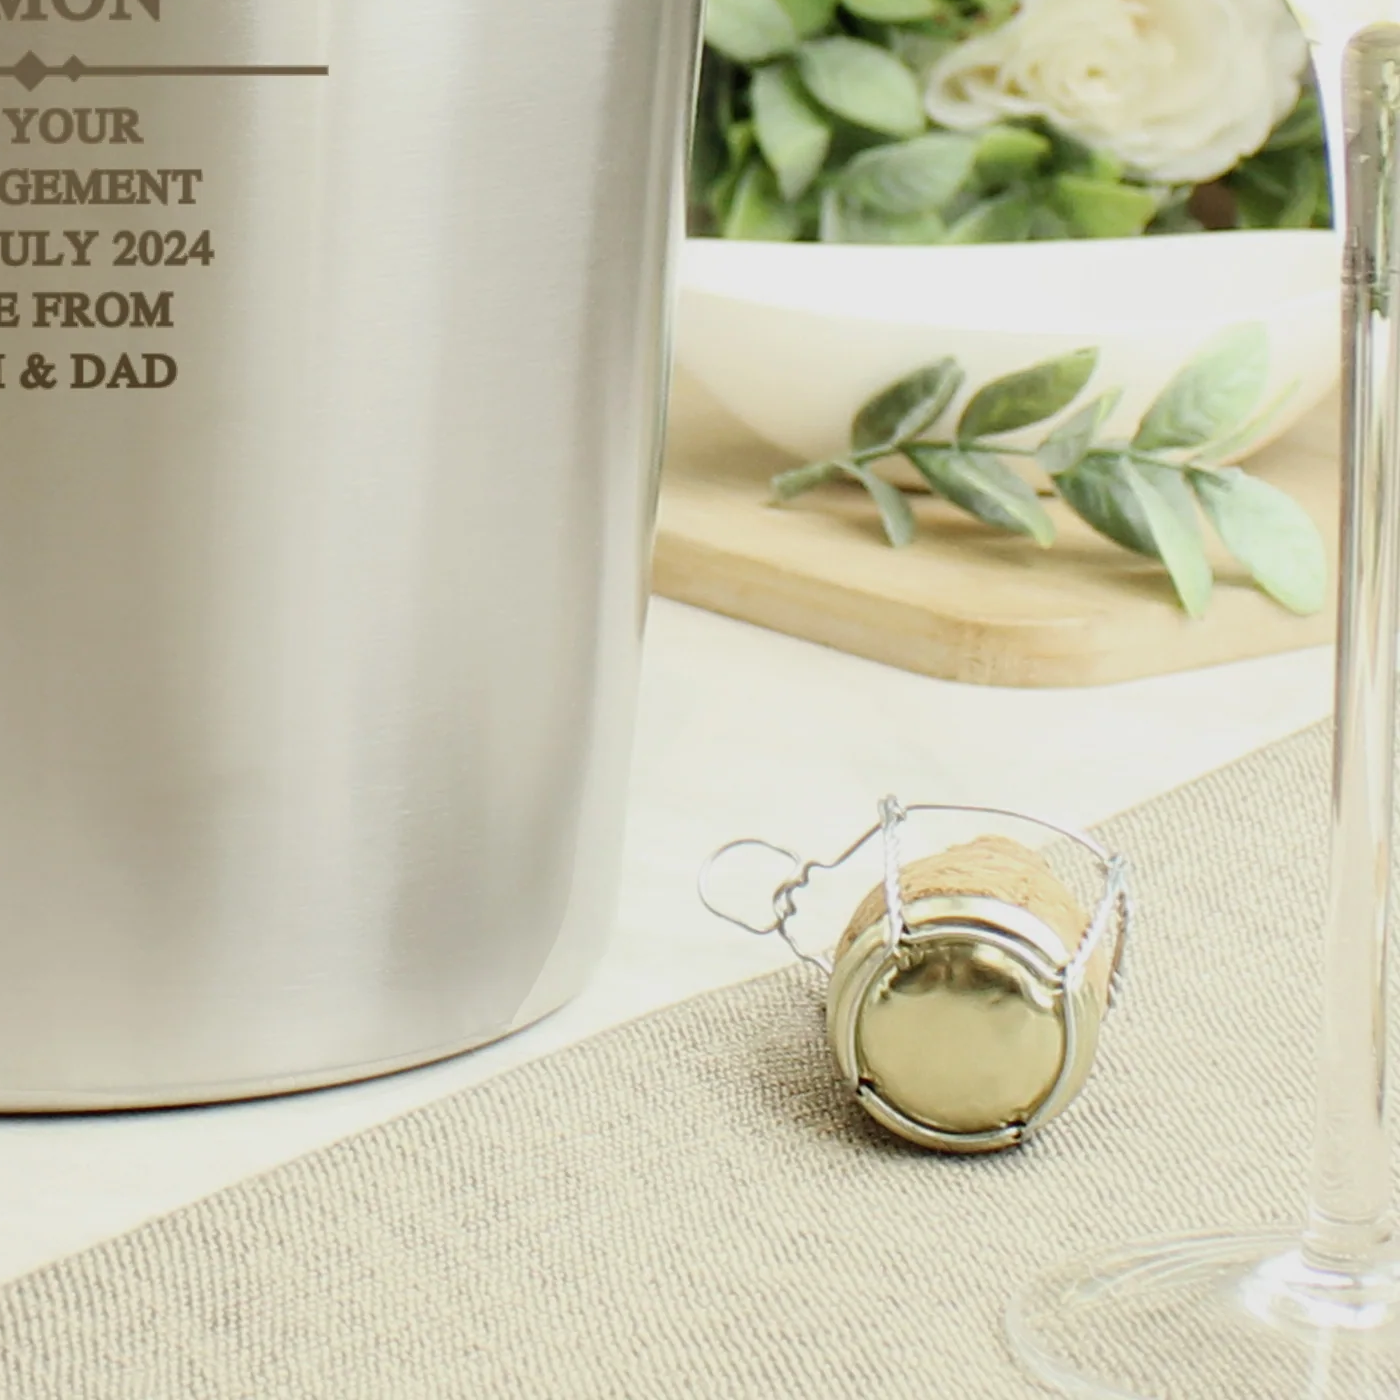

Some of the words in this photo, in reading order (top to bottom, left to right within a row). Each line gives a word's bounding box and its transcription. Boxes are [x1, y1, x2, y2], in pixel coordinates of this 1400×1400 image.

[2, 107, 143, 145] YOUR
[111, 229, 215, 267] 2024
[32, 291, 174, 328] FROM
[19, 353, 57, 390] &
[70, 353, 178, 390] DAD
